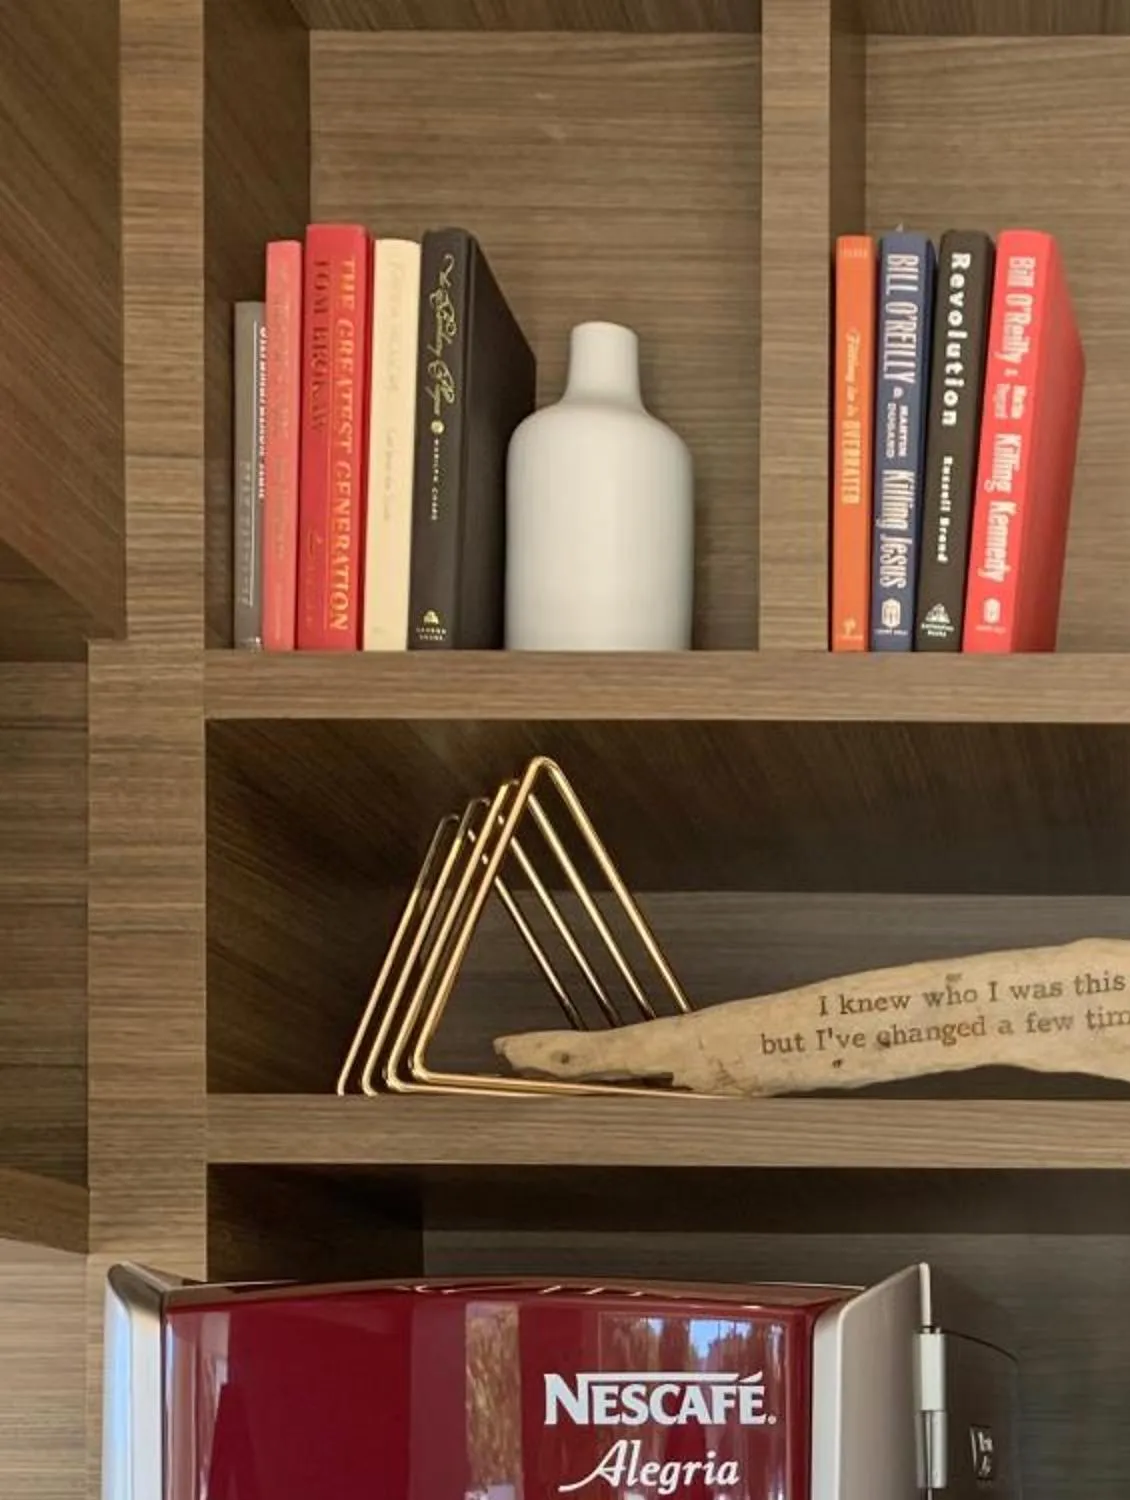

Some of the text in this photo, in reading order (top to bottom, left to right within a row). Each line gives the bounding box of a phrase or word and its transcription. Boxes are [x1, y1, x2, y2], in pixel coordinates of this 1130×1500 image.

[885, 254, 919, 295] BILL
[1007, 256, 1035, 288] Bill
[310, 260, 328, 434] TOM BROKAW
[883, 301, 916, 384] O'REILLY
[941, 253, 971, 426] Revolution
[995, 294, 1033, 363] O'Reilly
[330, 256, 355, 631] THE GREATEST GENERATION
[885, 403, 896, 458] DUGARD
[898, 404, 909, 457] MARTIN
[841, 420, 859, 504] OVERRATED
[985, 433, 1022, 493] Killing
[878, 470, 914, 529] Killing
[936, 457, 953, 563] Russell Brand
[880, 533, 910, 589] Jesus
[977, 501, 1016, 583] Kennedy
[818, 997, 827, 1016] I
[840, 992, 911, 1015] knew
[923, 984, 978, 1011] who
[989, 981, 998, 1001] I
[1010, 979, 1064, 1000] was
[1074, 971, 1125, 995] this
[761, 1031, 805, 1055] but
[815, 1026, 866, 1051] I've
[876, 1015, 986, 1048] changed
[997, 1018, 1013, 1035] a
[1025, 1009, 1074, 1033] few
[558, 1439, 739, 1495] Alegria
